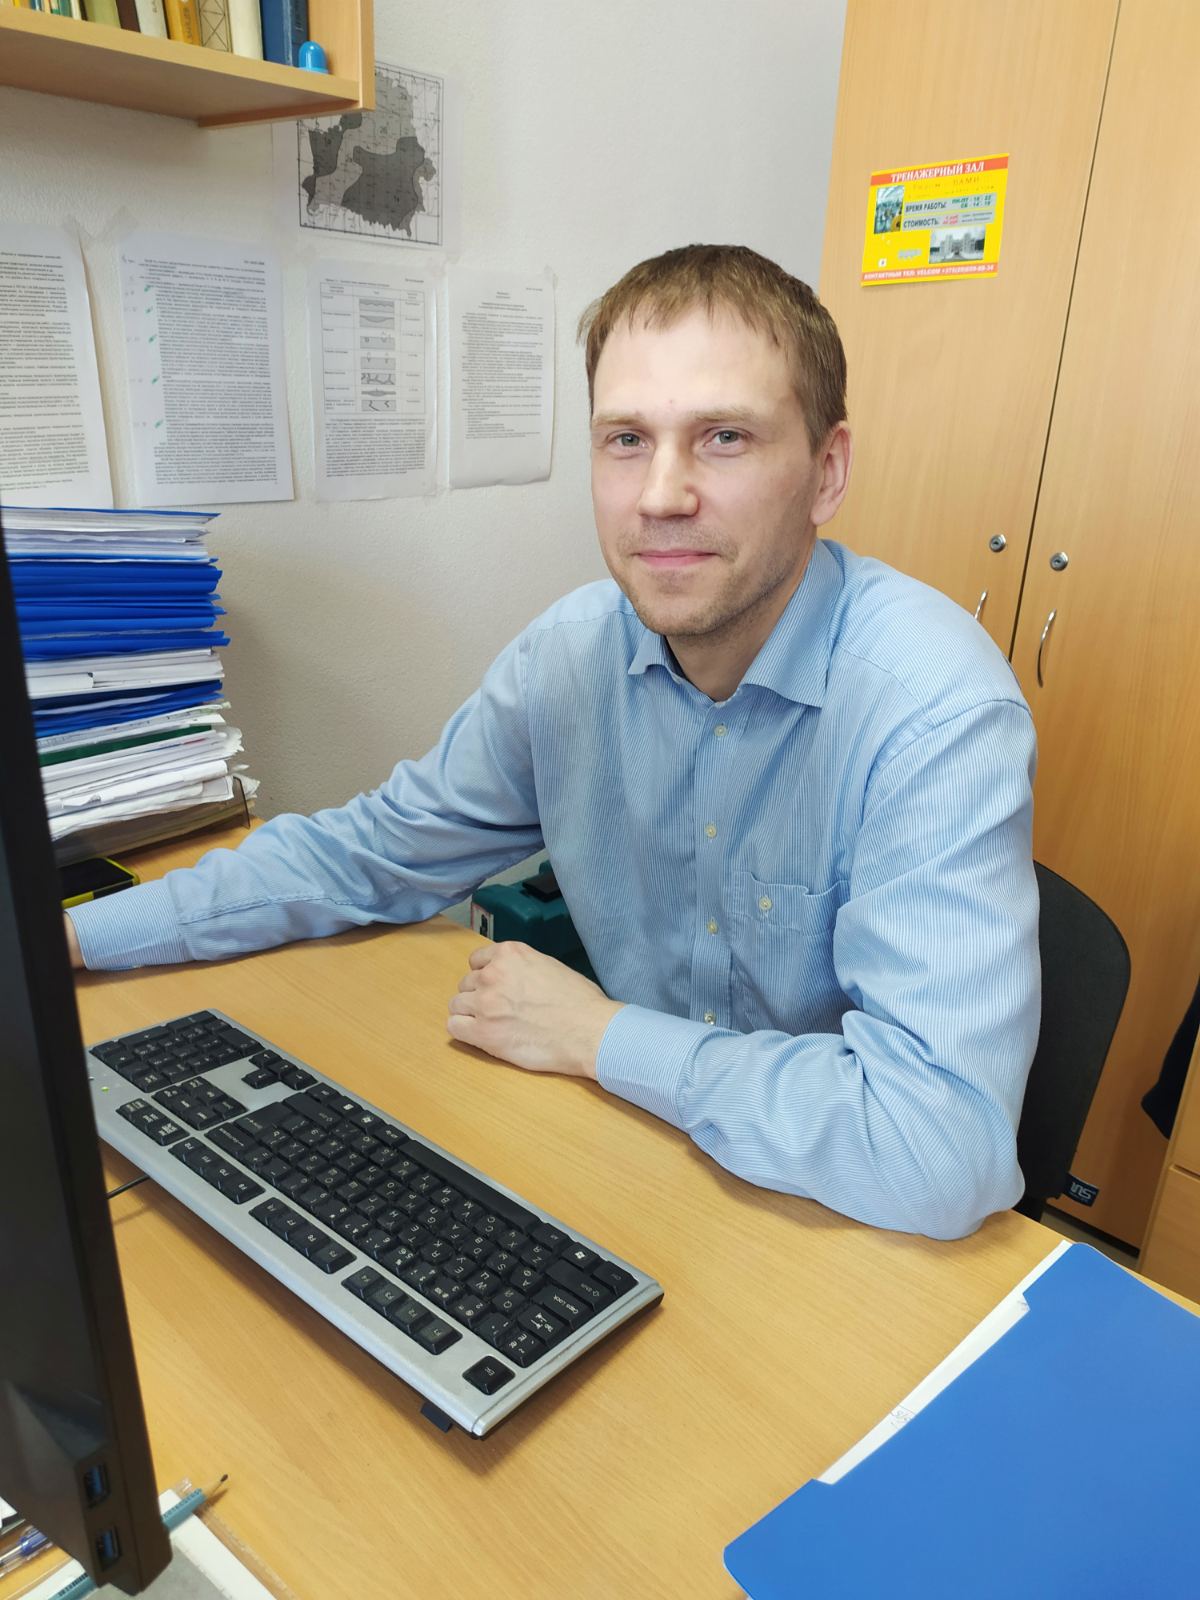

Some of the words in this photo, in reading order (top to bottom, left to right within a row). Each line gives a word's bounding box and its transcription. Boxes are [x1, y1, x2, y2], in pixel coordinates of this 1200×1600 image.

[890, 163, 964, 183] ТРЕНАЖЕРНЫЙ
[965, 161, 985, 172] ЗАЛ
[307, 1234, 316, 1242] F6
[454, 1266, 464, 1274] E
[475, 1281, 487, 1289] W
[384, 1292, 394, 1300] F3
[503, 1300, 512, 1308] Q
[566, 1303, 578, 1314] Caps
[408, 1309, 417, 1317] F2
[433, 1328, 442, 1336] F1
